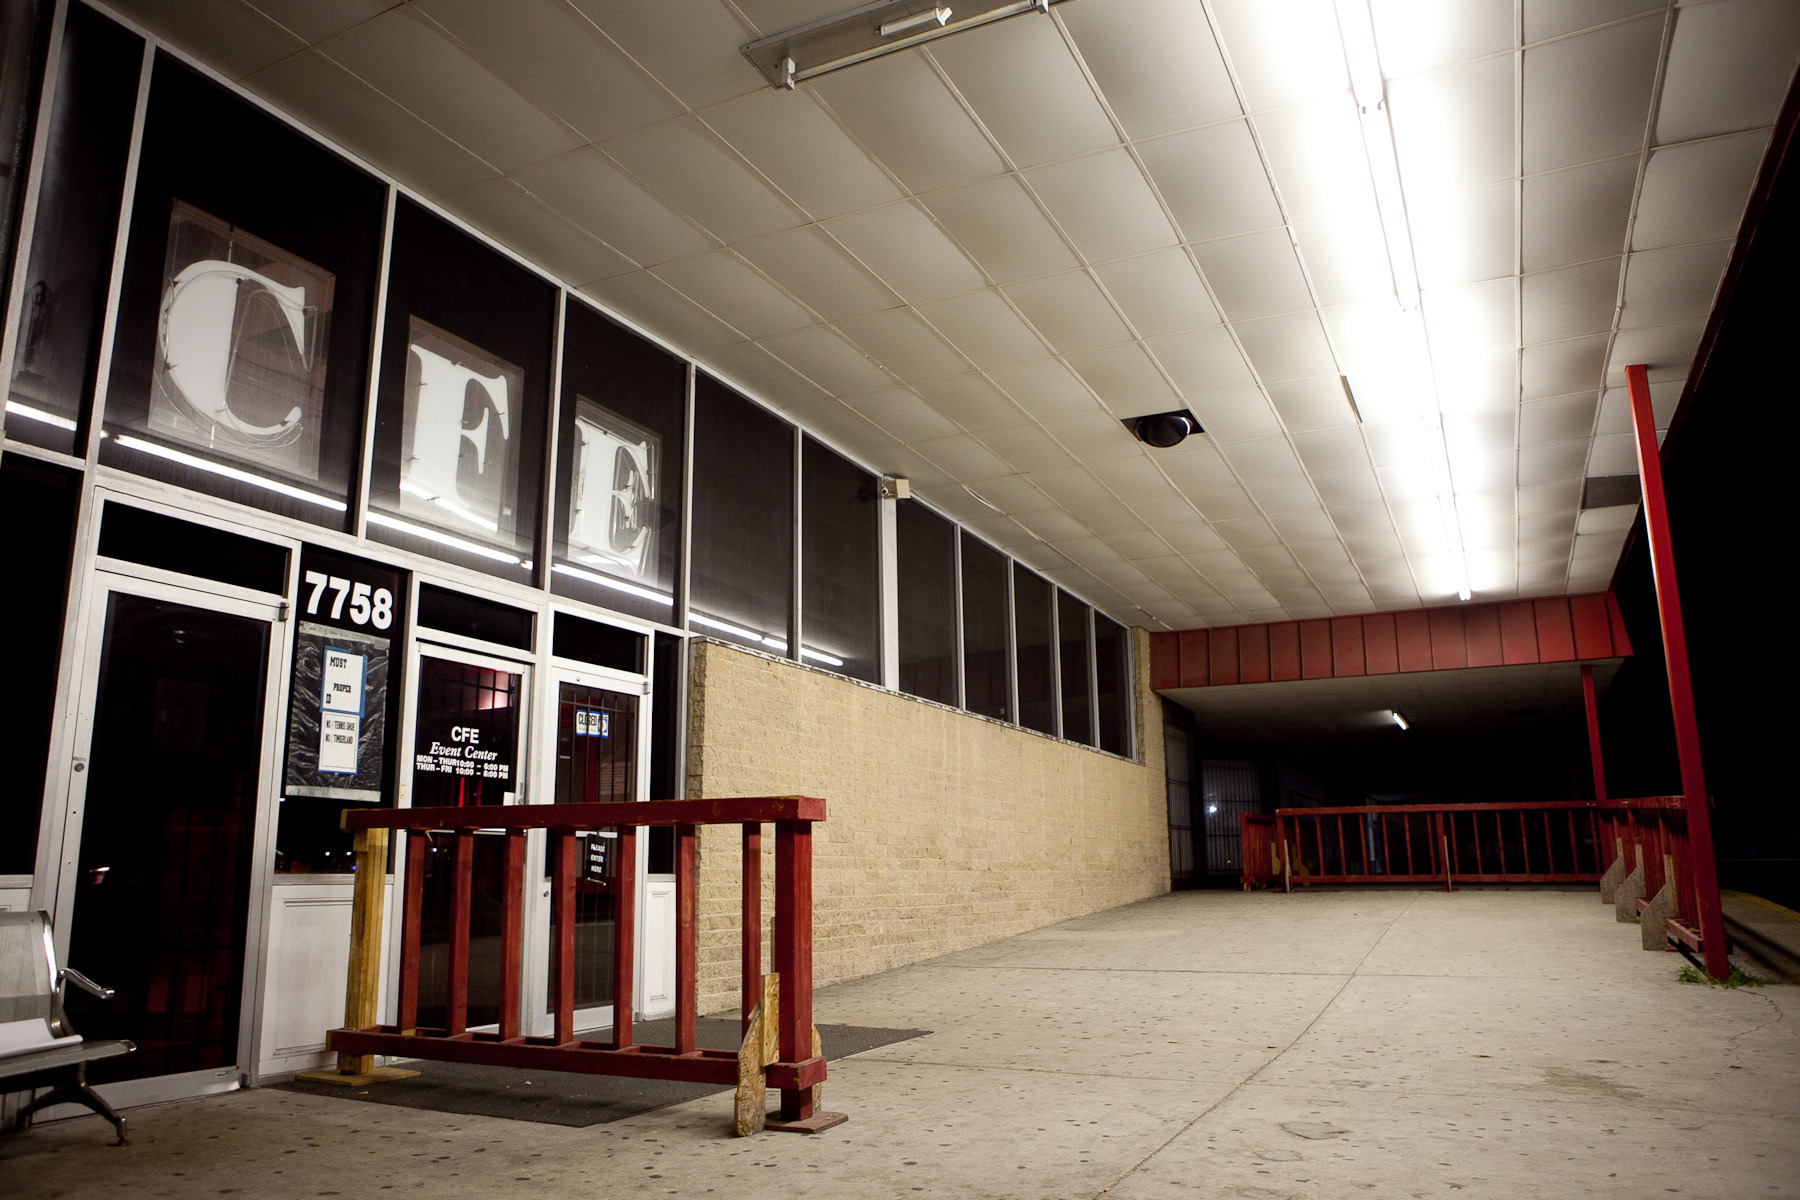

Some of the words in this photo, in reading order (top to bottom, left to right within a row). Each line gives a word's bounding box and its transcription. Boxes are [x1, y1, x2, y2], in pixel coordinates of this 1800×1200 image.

[305, 569, 393, 630] 7758
[329, 656, 347, 669] MUST
[333, 683, 351, 693] PROPER
[451, 725, 480, 744] CFE
[429, 741, 462, 757] Event
[464, 746, 498, 761] Center
[455, 767, 474, 776] 10:00
[498, 771, 509, 779] PM
[498, 764, 509, 772] PM
